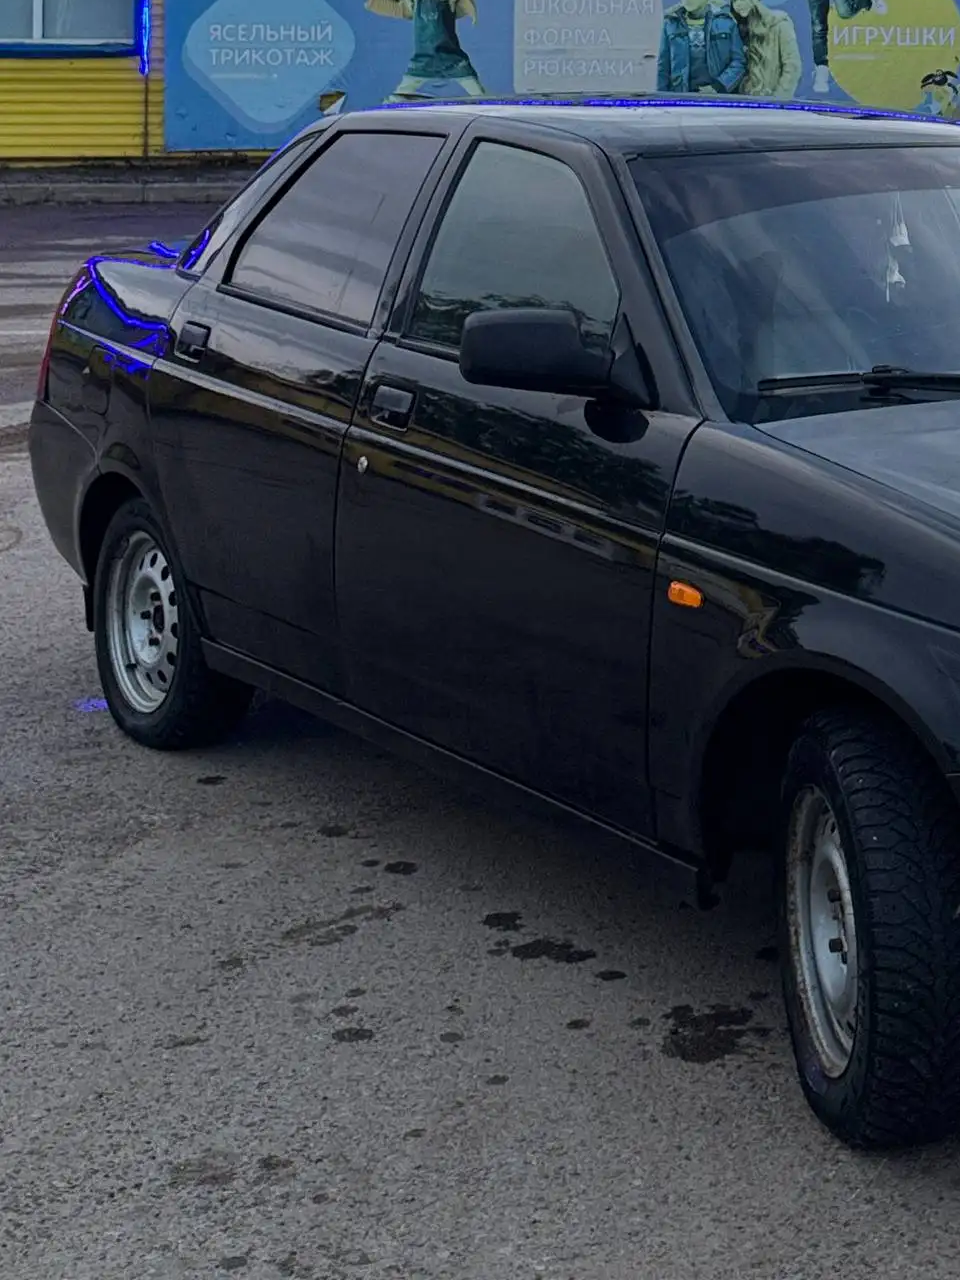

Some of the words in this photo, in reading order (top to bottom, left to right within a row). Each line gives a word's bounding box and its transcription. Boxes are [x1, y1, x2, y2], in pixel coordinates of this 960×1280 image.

[208, 19, 334, 43] ЯСЕЛЬНЫЙ
[523, 27, 612, 46] ФОРМА
[833, 24, 956, 49] ИГРУШКИ
[208, 47, 334, 68] ТРИКОТАЖ
[523, 58, 634, 77] РЮКЗАКИ
